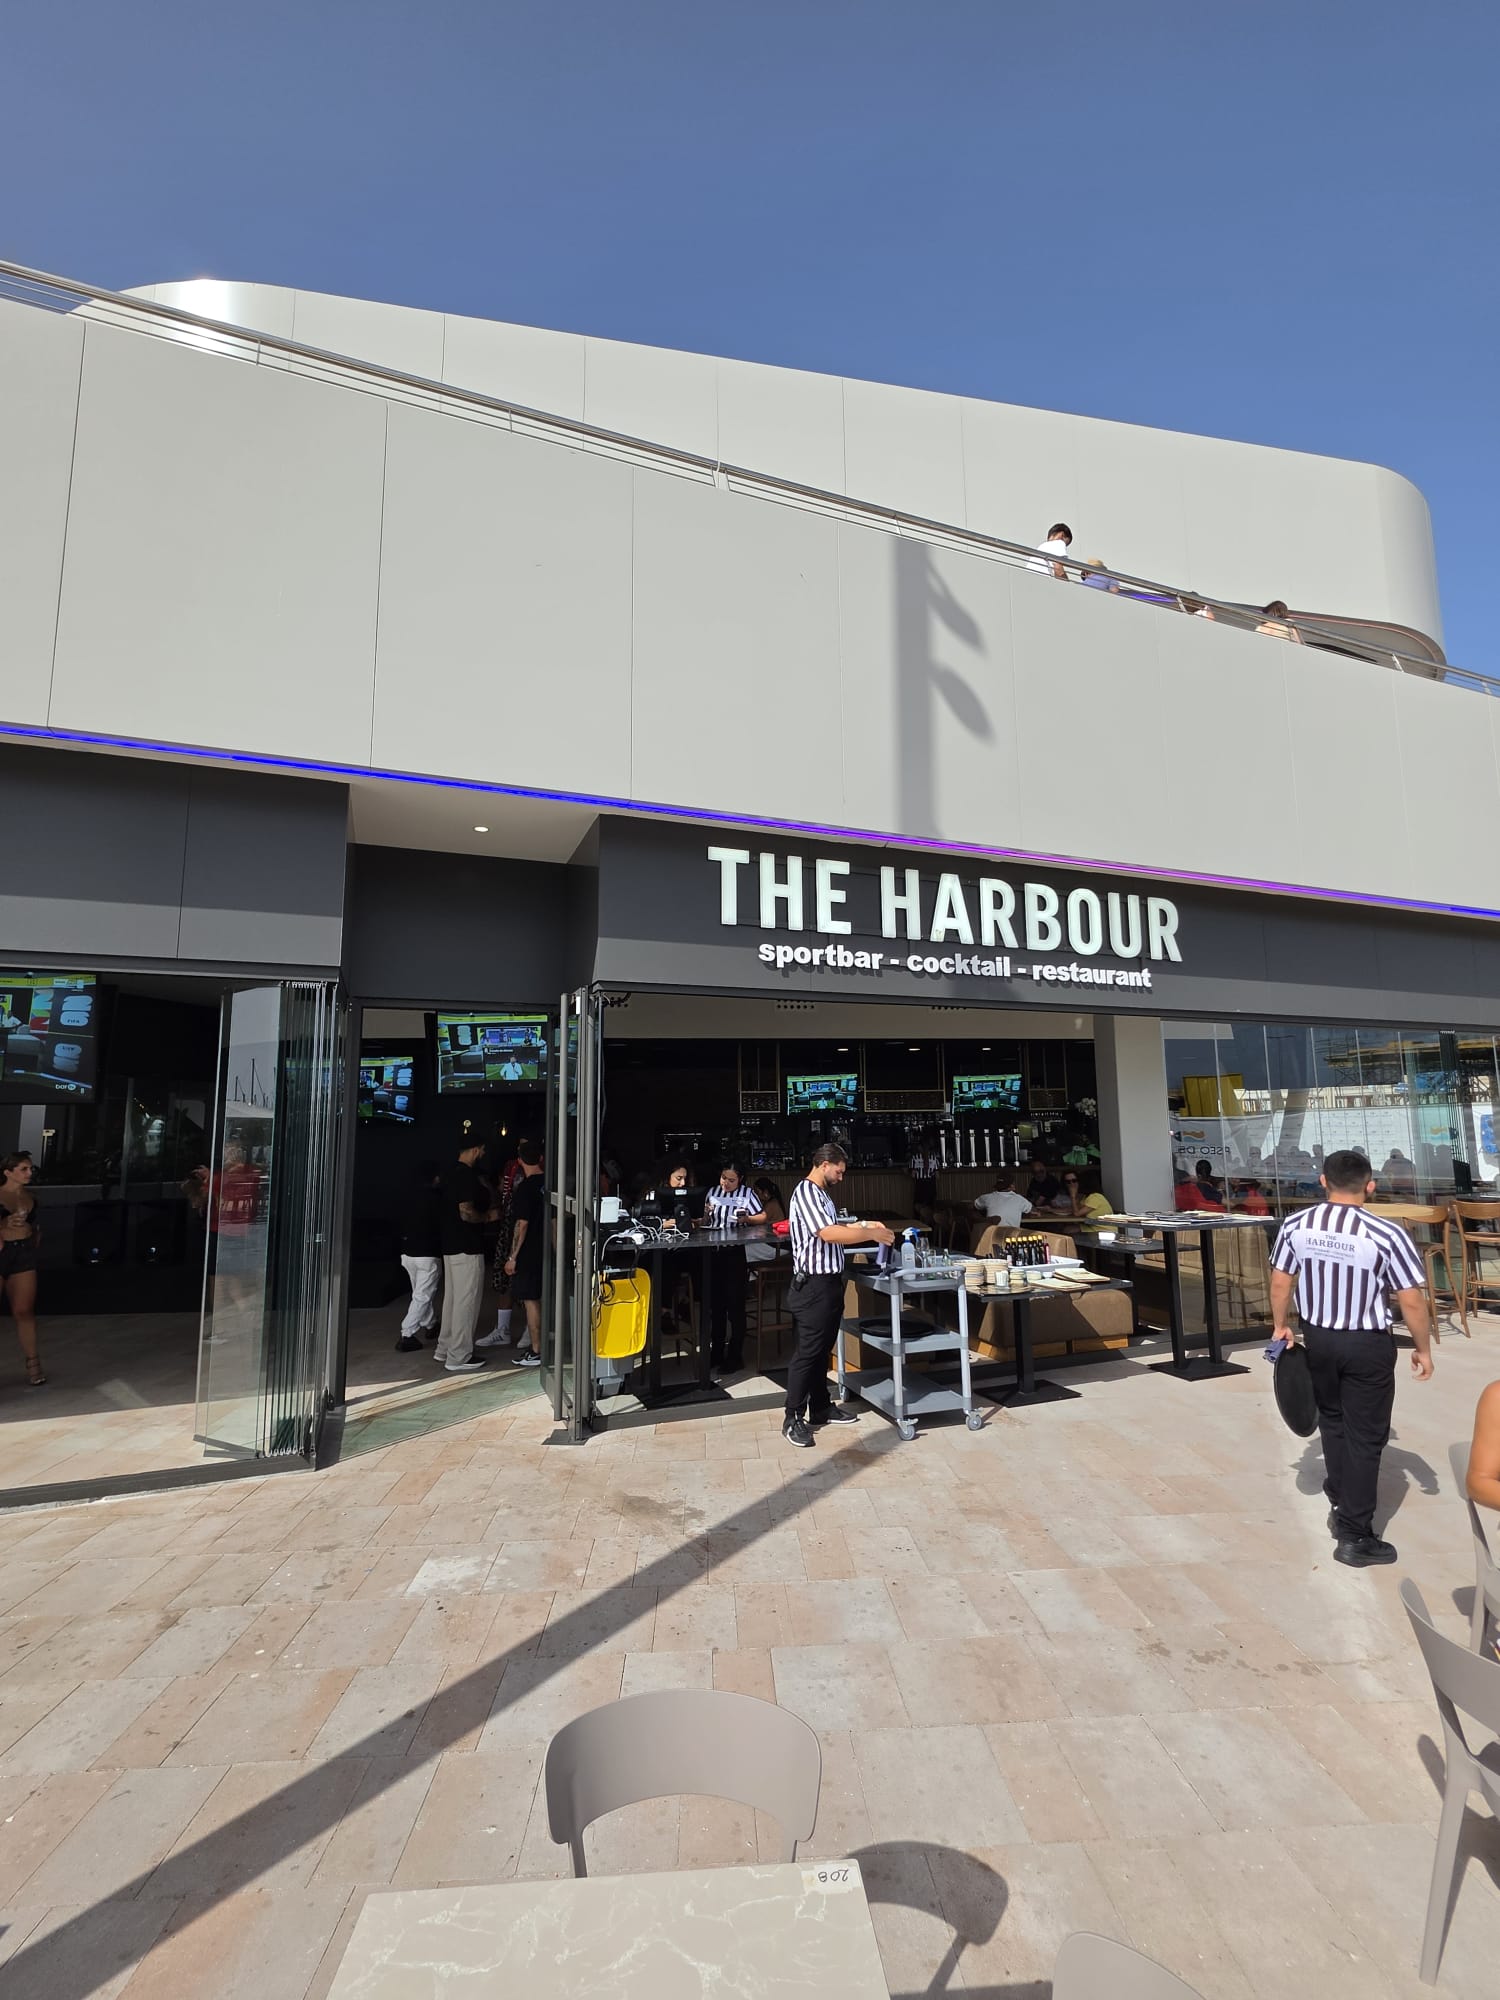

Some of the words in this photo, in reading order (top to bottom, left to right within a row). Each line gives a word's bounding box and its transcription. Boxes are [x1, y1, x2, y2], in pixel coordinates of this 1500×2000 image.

[708, 846, 852, 935] THE
[880, 866, 1183, 962] HARBOUR
[758, 943, 884, 969] sportbar
[906, 953, 1010, 977] cocktail
[1032, 962, 1152, 988] restaurant
[1306, 1237, 1355, 1252] HARBOUR
[817, 1869, 849, 1883] 208
